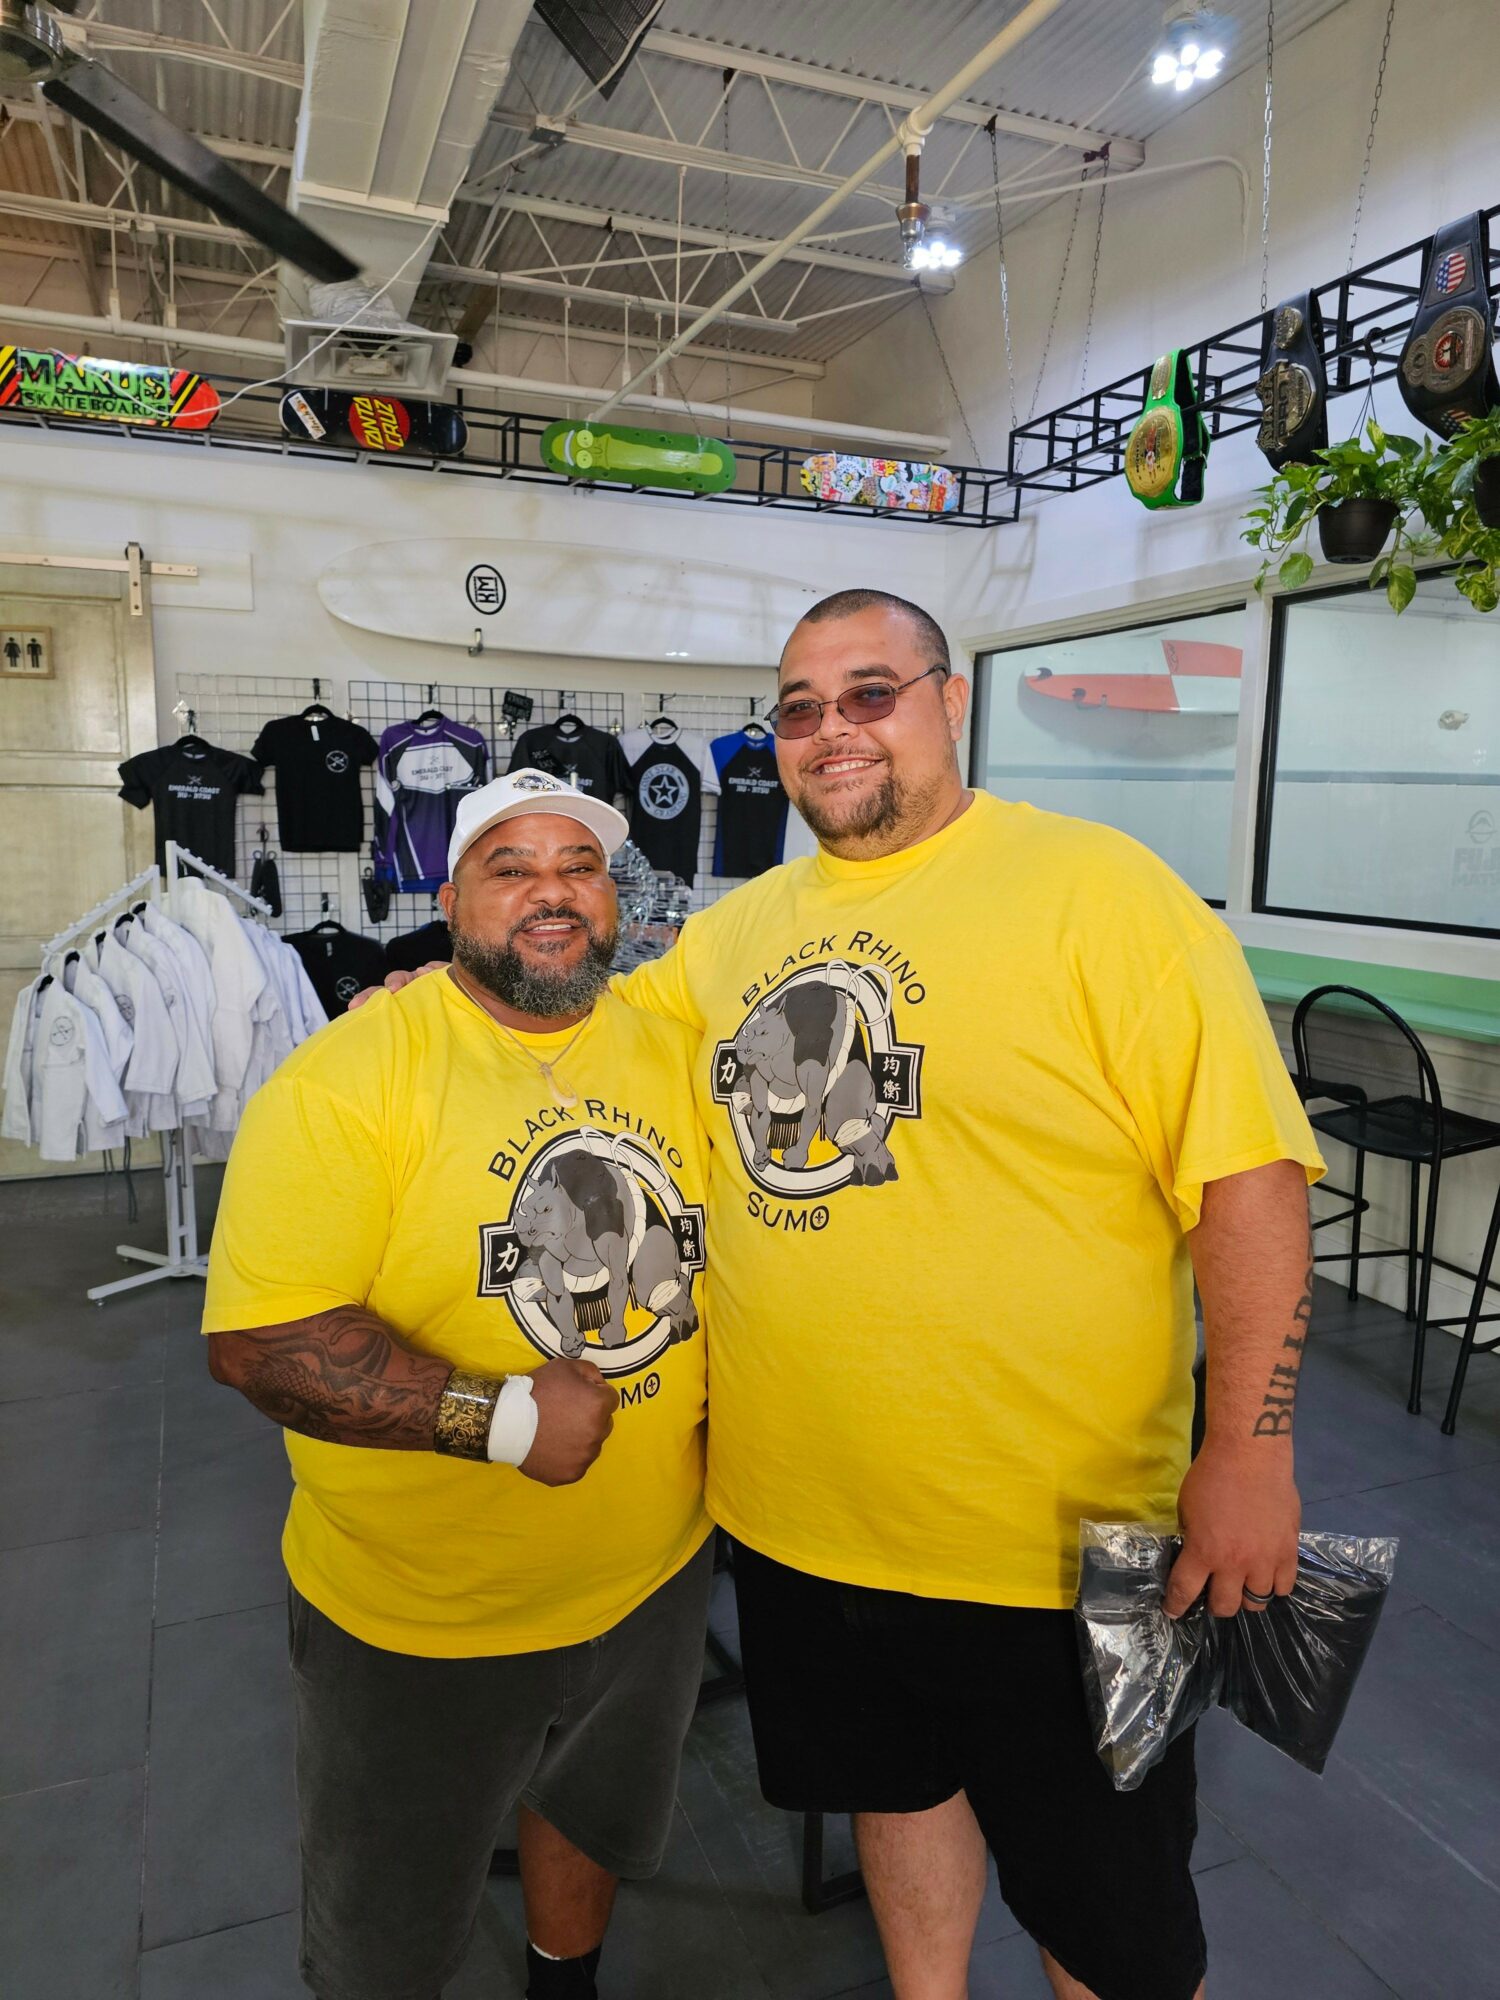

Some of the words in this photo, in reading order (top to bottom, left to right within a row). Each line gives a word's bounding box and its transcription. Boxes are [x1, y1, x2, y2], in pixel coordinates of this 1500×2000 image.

[23, 391, 169, 420] SKATEBOARDS
[353, 396, 385, 450] SANTA
[374, 399, 404, 448] CRUZ
[728, 777, 757, 786] EMERALD
[757, 779, 779, 788] COAST
[741, 934, 838, 1007] BLACK
[848, 930, 926, 1005] RHINO
[719, 1056, 737, 1084] 力
[882, 1056, 902, 1102] 均衡
[487, 1104, 575, 1182] BLACK
[584, 1099, 683, 1169] RHINO
[747, 1191, 830, 1233] SUMO
[496, 1243, 520, 1273] 力
[680, 1217, 696, 1260] 均衡
[620, 1372, 661, 1409] MO
